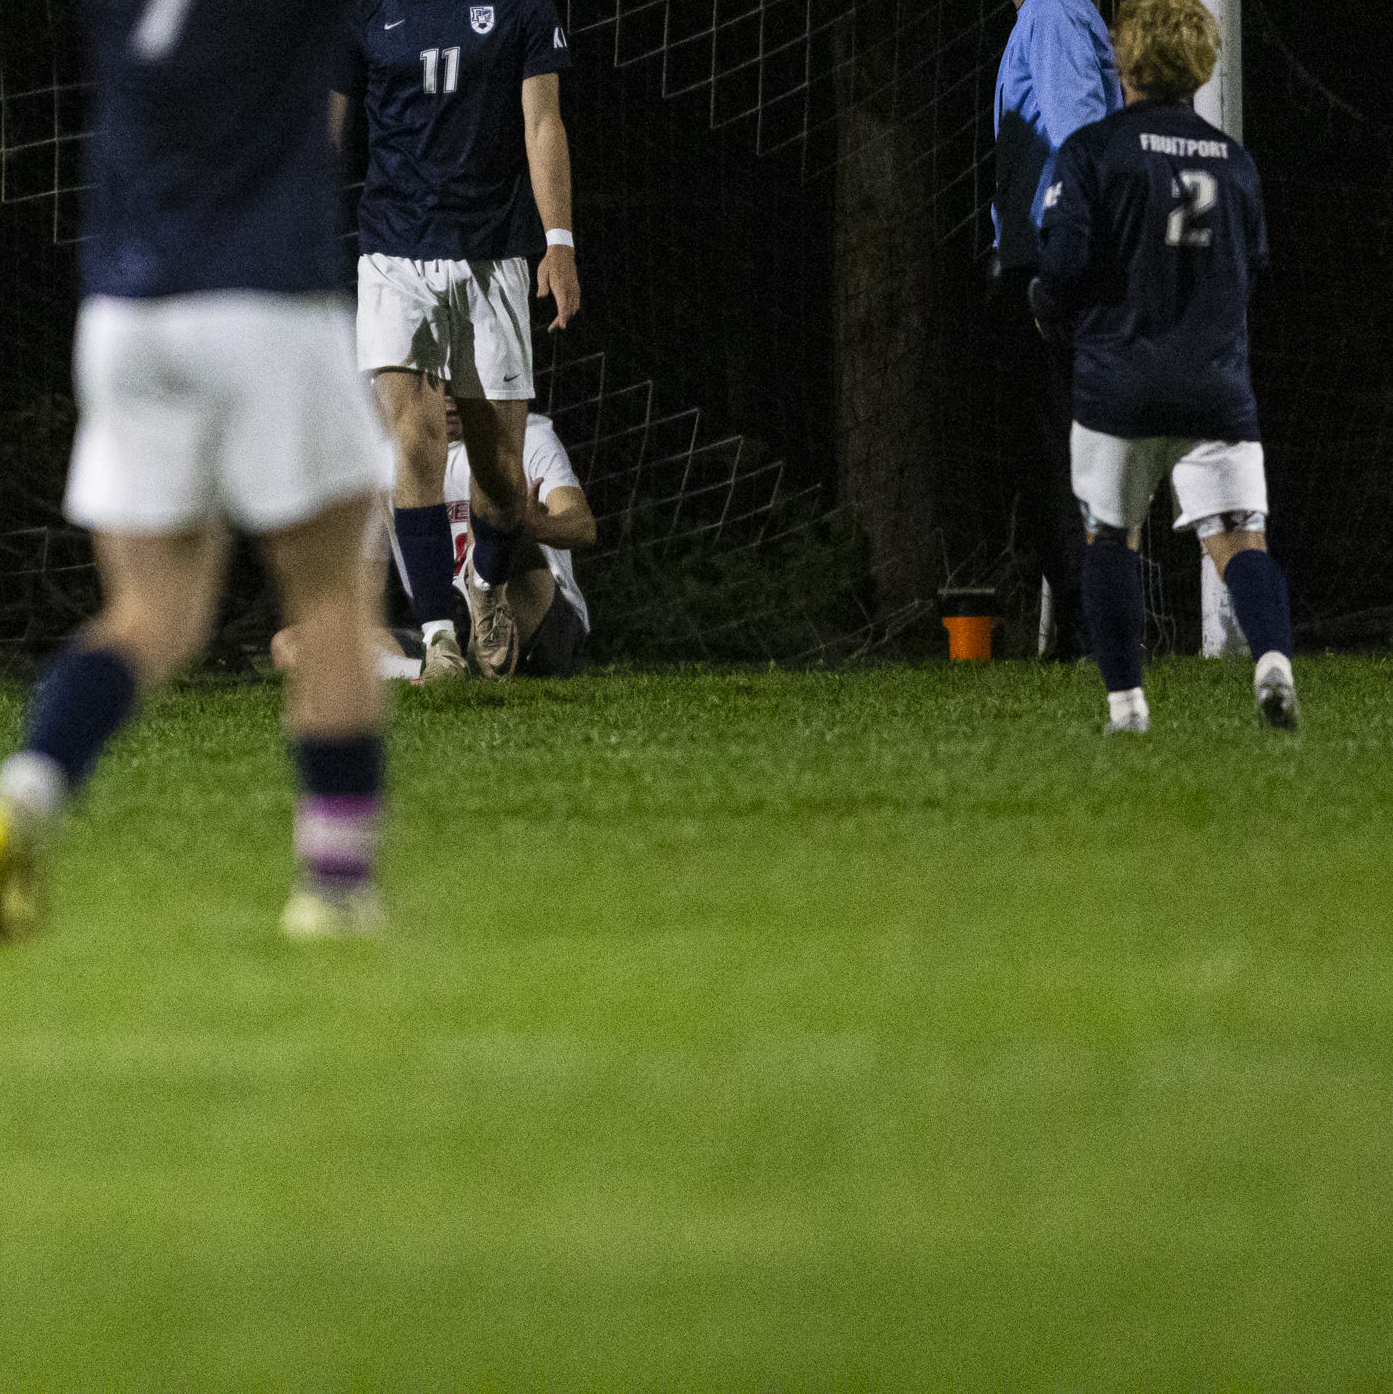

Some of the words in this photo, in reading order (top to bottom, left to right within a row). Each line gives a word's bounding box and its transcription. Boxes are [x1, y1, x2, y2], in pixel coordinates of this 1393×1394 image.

[420, 46, 461, 94] 11
[1139, 133, 1229, 159] FRUITPORT
[1165, 170, 1218, 246] 2
